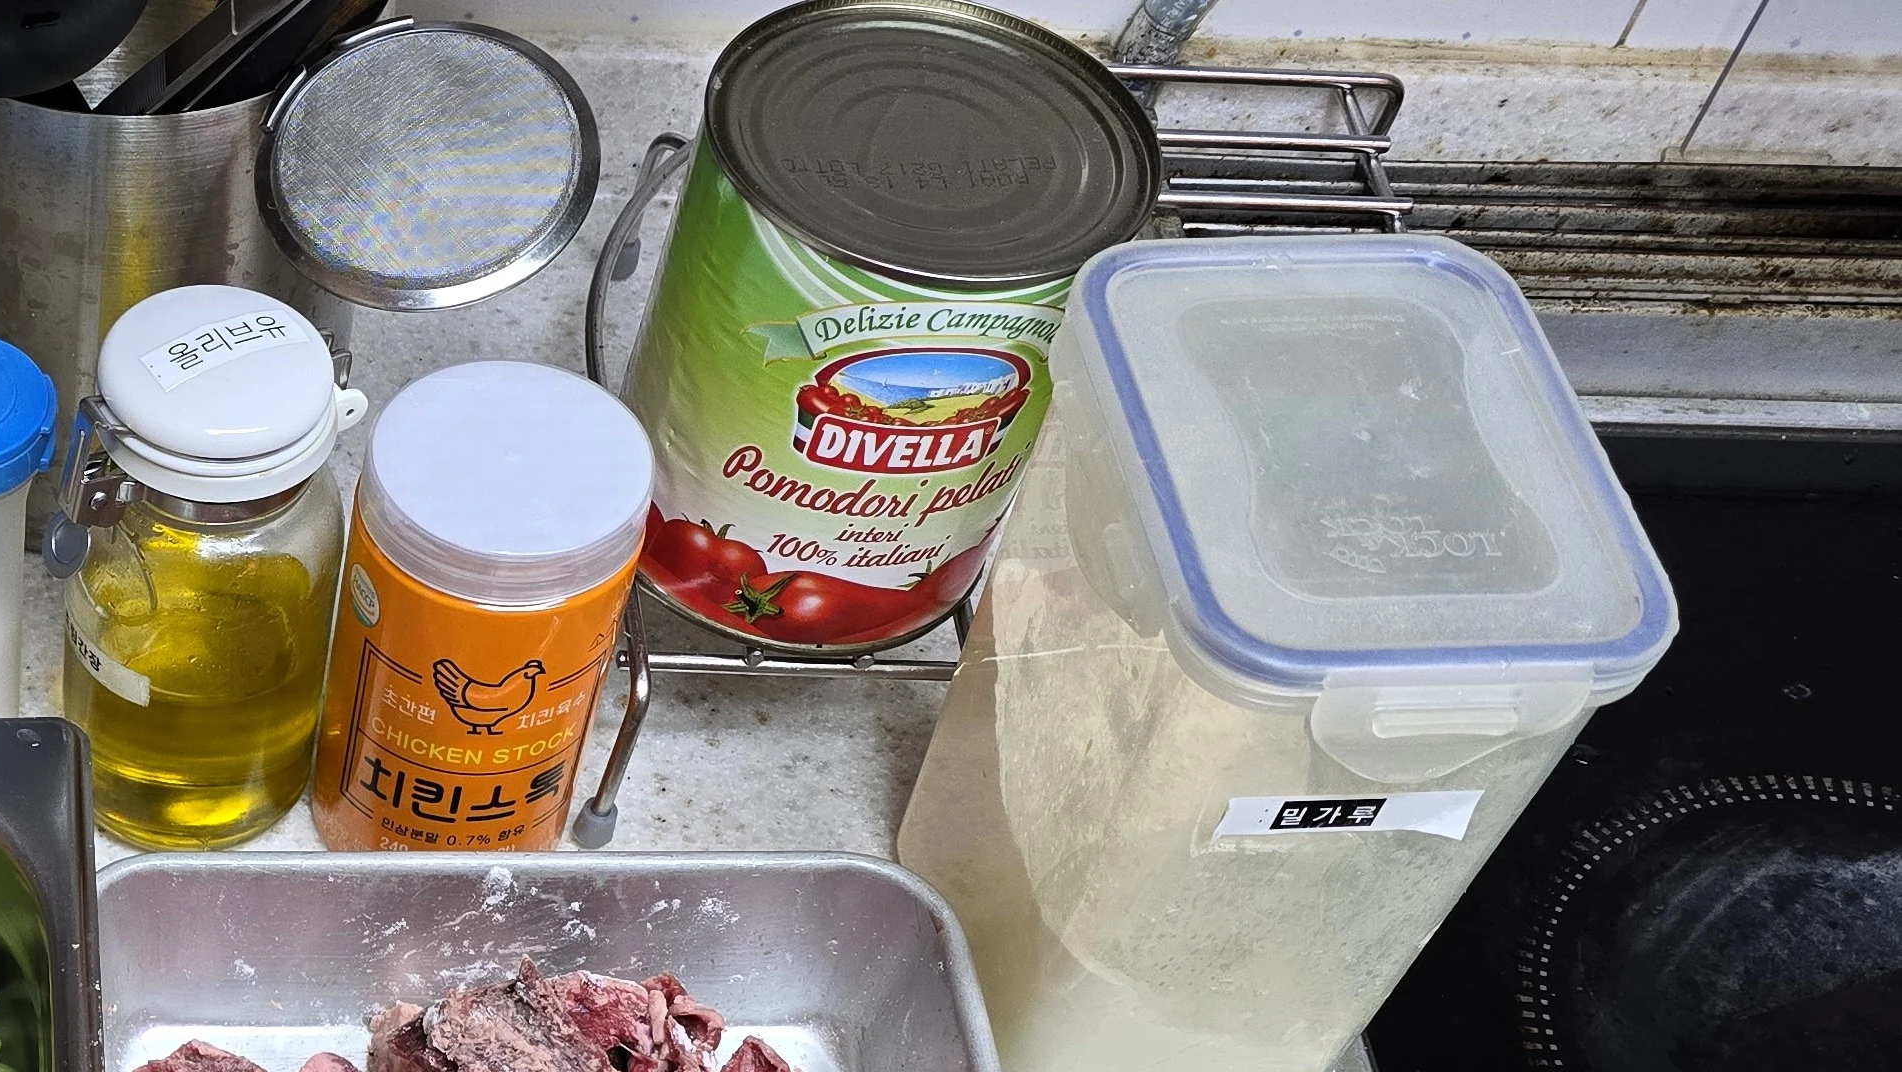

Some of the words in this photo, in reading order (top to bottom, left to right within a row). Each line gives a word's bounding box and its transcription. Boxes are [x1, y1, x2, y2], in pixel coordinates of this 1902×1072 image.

[167, 316, 286, 370] 올리브유
[814, 305, 920, 343] Delizie
[815, 422, 988, 469] DIVELLA
[721, 444, 929, 518] Pomodori
[914, 440, 1034, 528] pelati
[765, 533, 839, 567] 100%
[841, 535, 952, 568] italiani
[834, 523, 910, 543] interi
[381, 684, 436, 725] 초간편
[515, 691, 586, 730] 치킨육수
[370, 715, 483, 766] CHICKEN
[491, 721, 577, 765] STOCK
[359, 755, 566, 824] 치킨스톡
[446, 834, 492, 846] 0.7%
[497, 824, 527, 842] 함유
[1279, 805, 1378, 826] 밀가루
